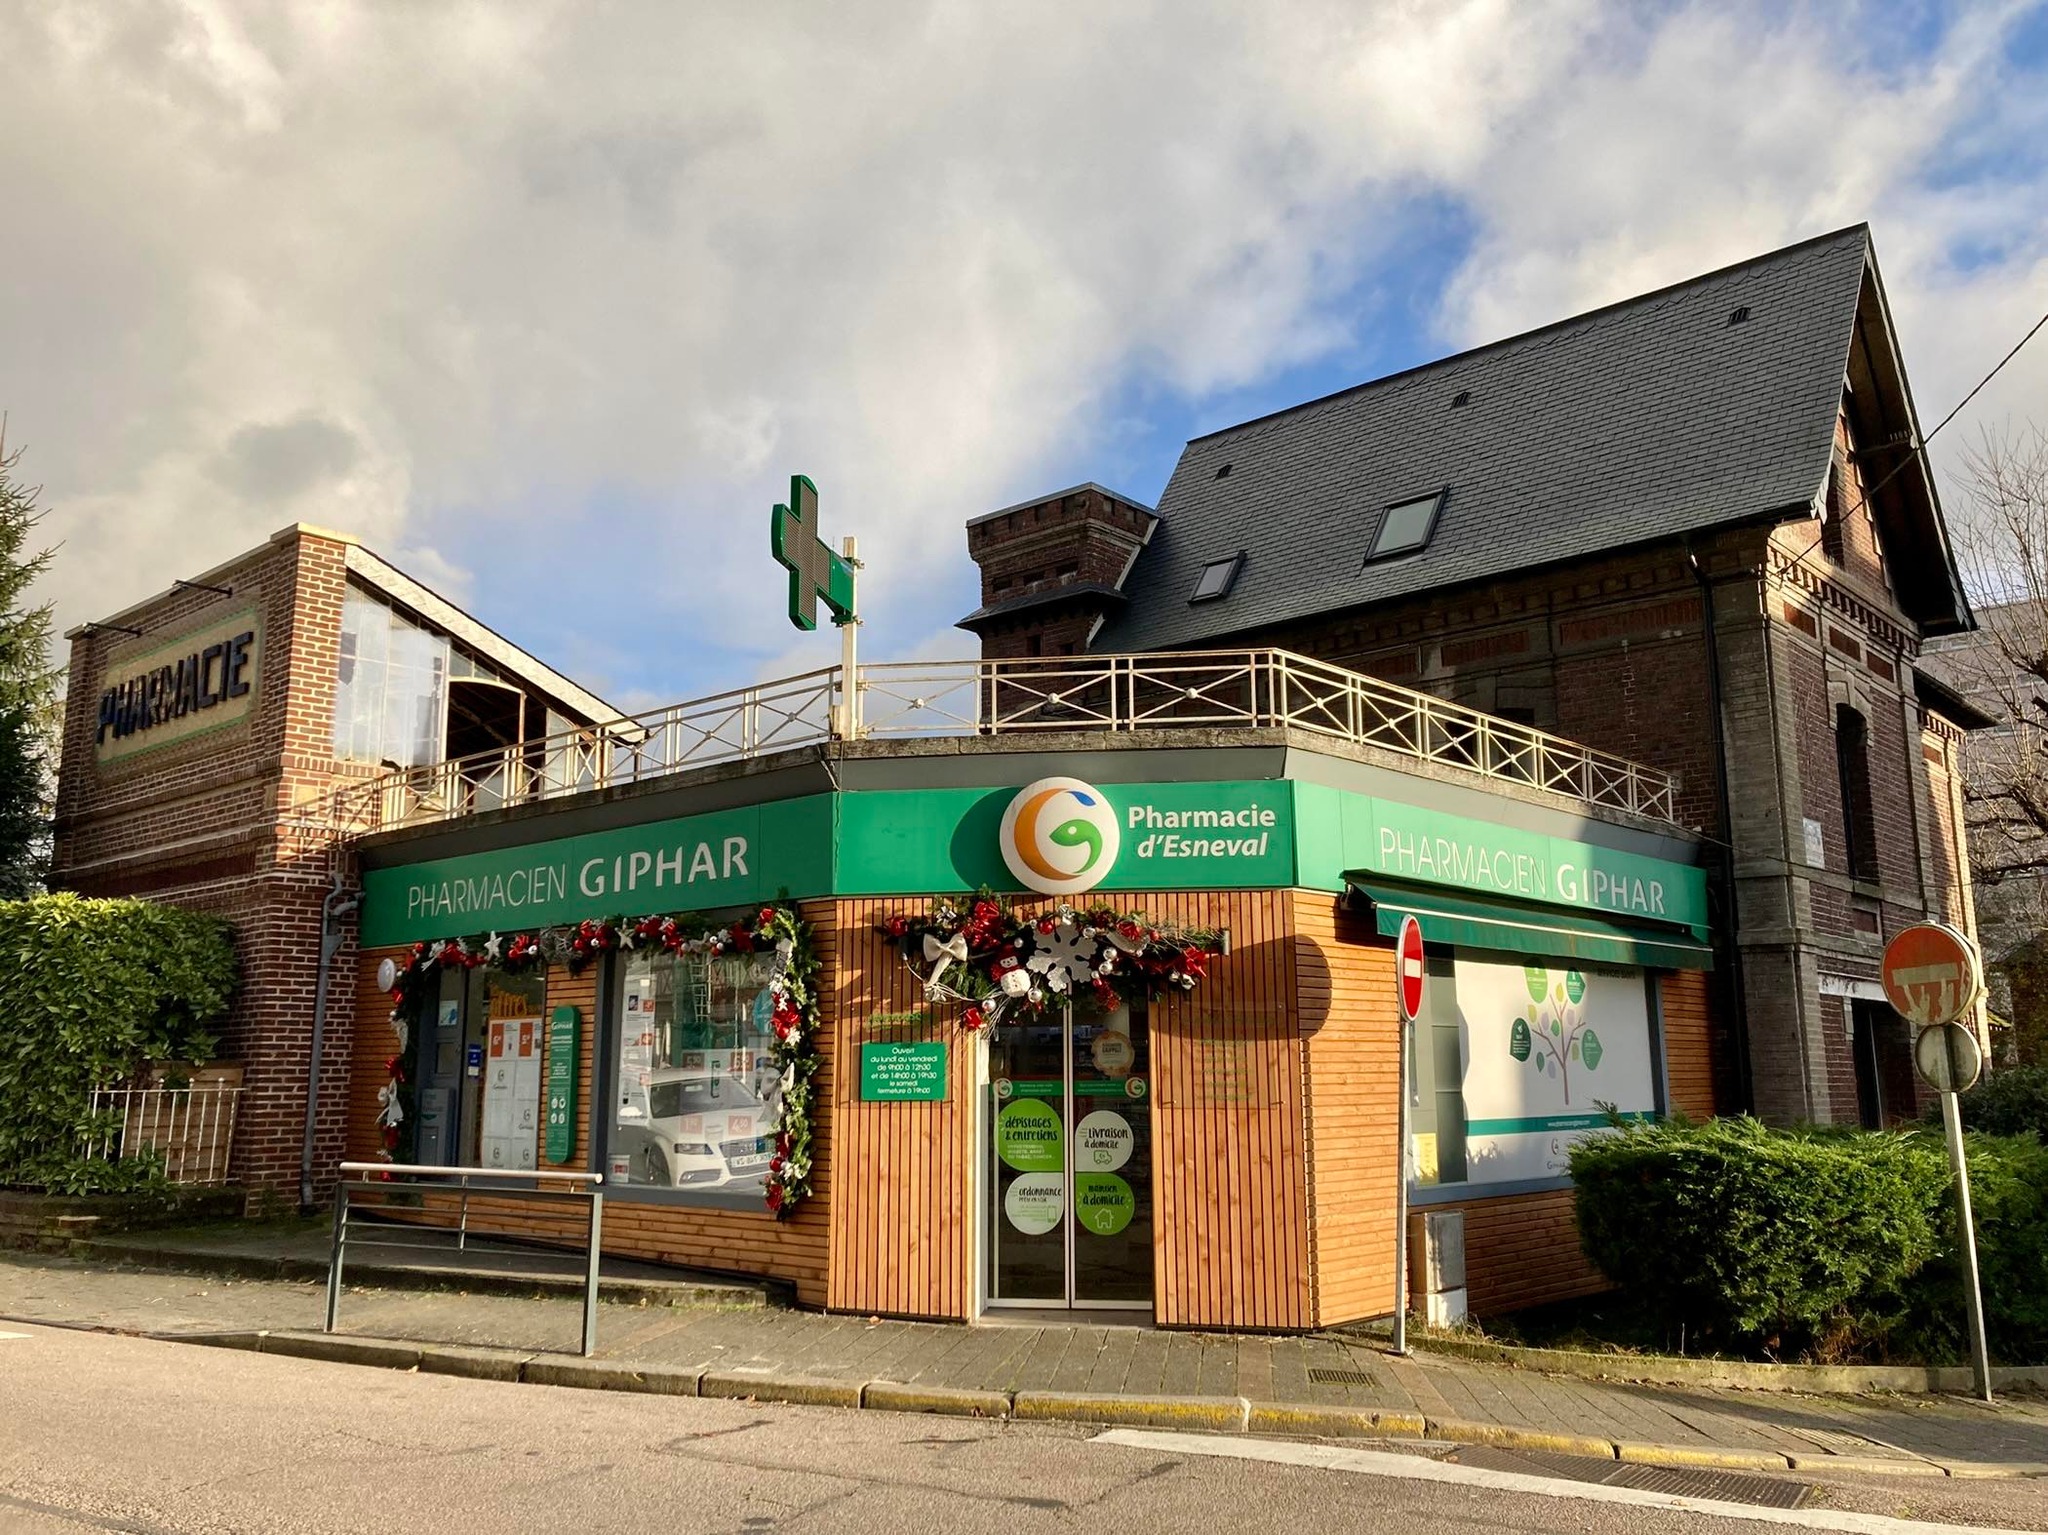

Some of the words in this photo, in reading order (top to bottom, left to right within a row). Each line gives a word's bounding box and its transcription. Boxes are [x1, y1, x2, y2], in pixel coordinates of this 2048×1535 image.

[95, 632, 254, 744] PHARMACIE
[1128, 804, 1276, 828] Pharmacie
[1137, 832, 1269, 858] d'Esneval
[408, 863, 567, 919] PHARMACIEN
[579, 836, 749, 898] GIPHAR
[1380, 827, 1546, 895] PHARMACIEN
[1556, 863, 1666, 915] GIPHAR
[1005, 1115, 1052, 1129] dépistages
[1012, 1129, 1058, 1141] entretiens
[1091, 1139, 1119, 1149] domicile
[1018, 1186, 1062, 1197] ordonnance
[1090, 1194, 1125, 1206] domicile
